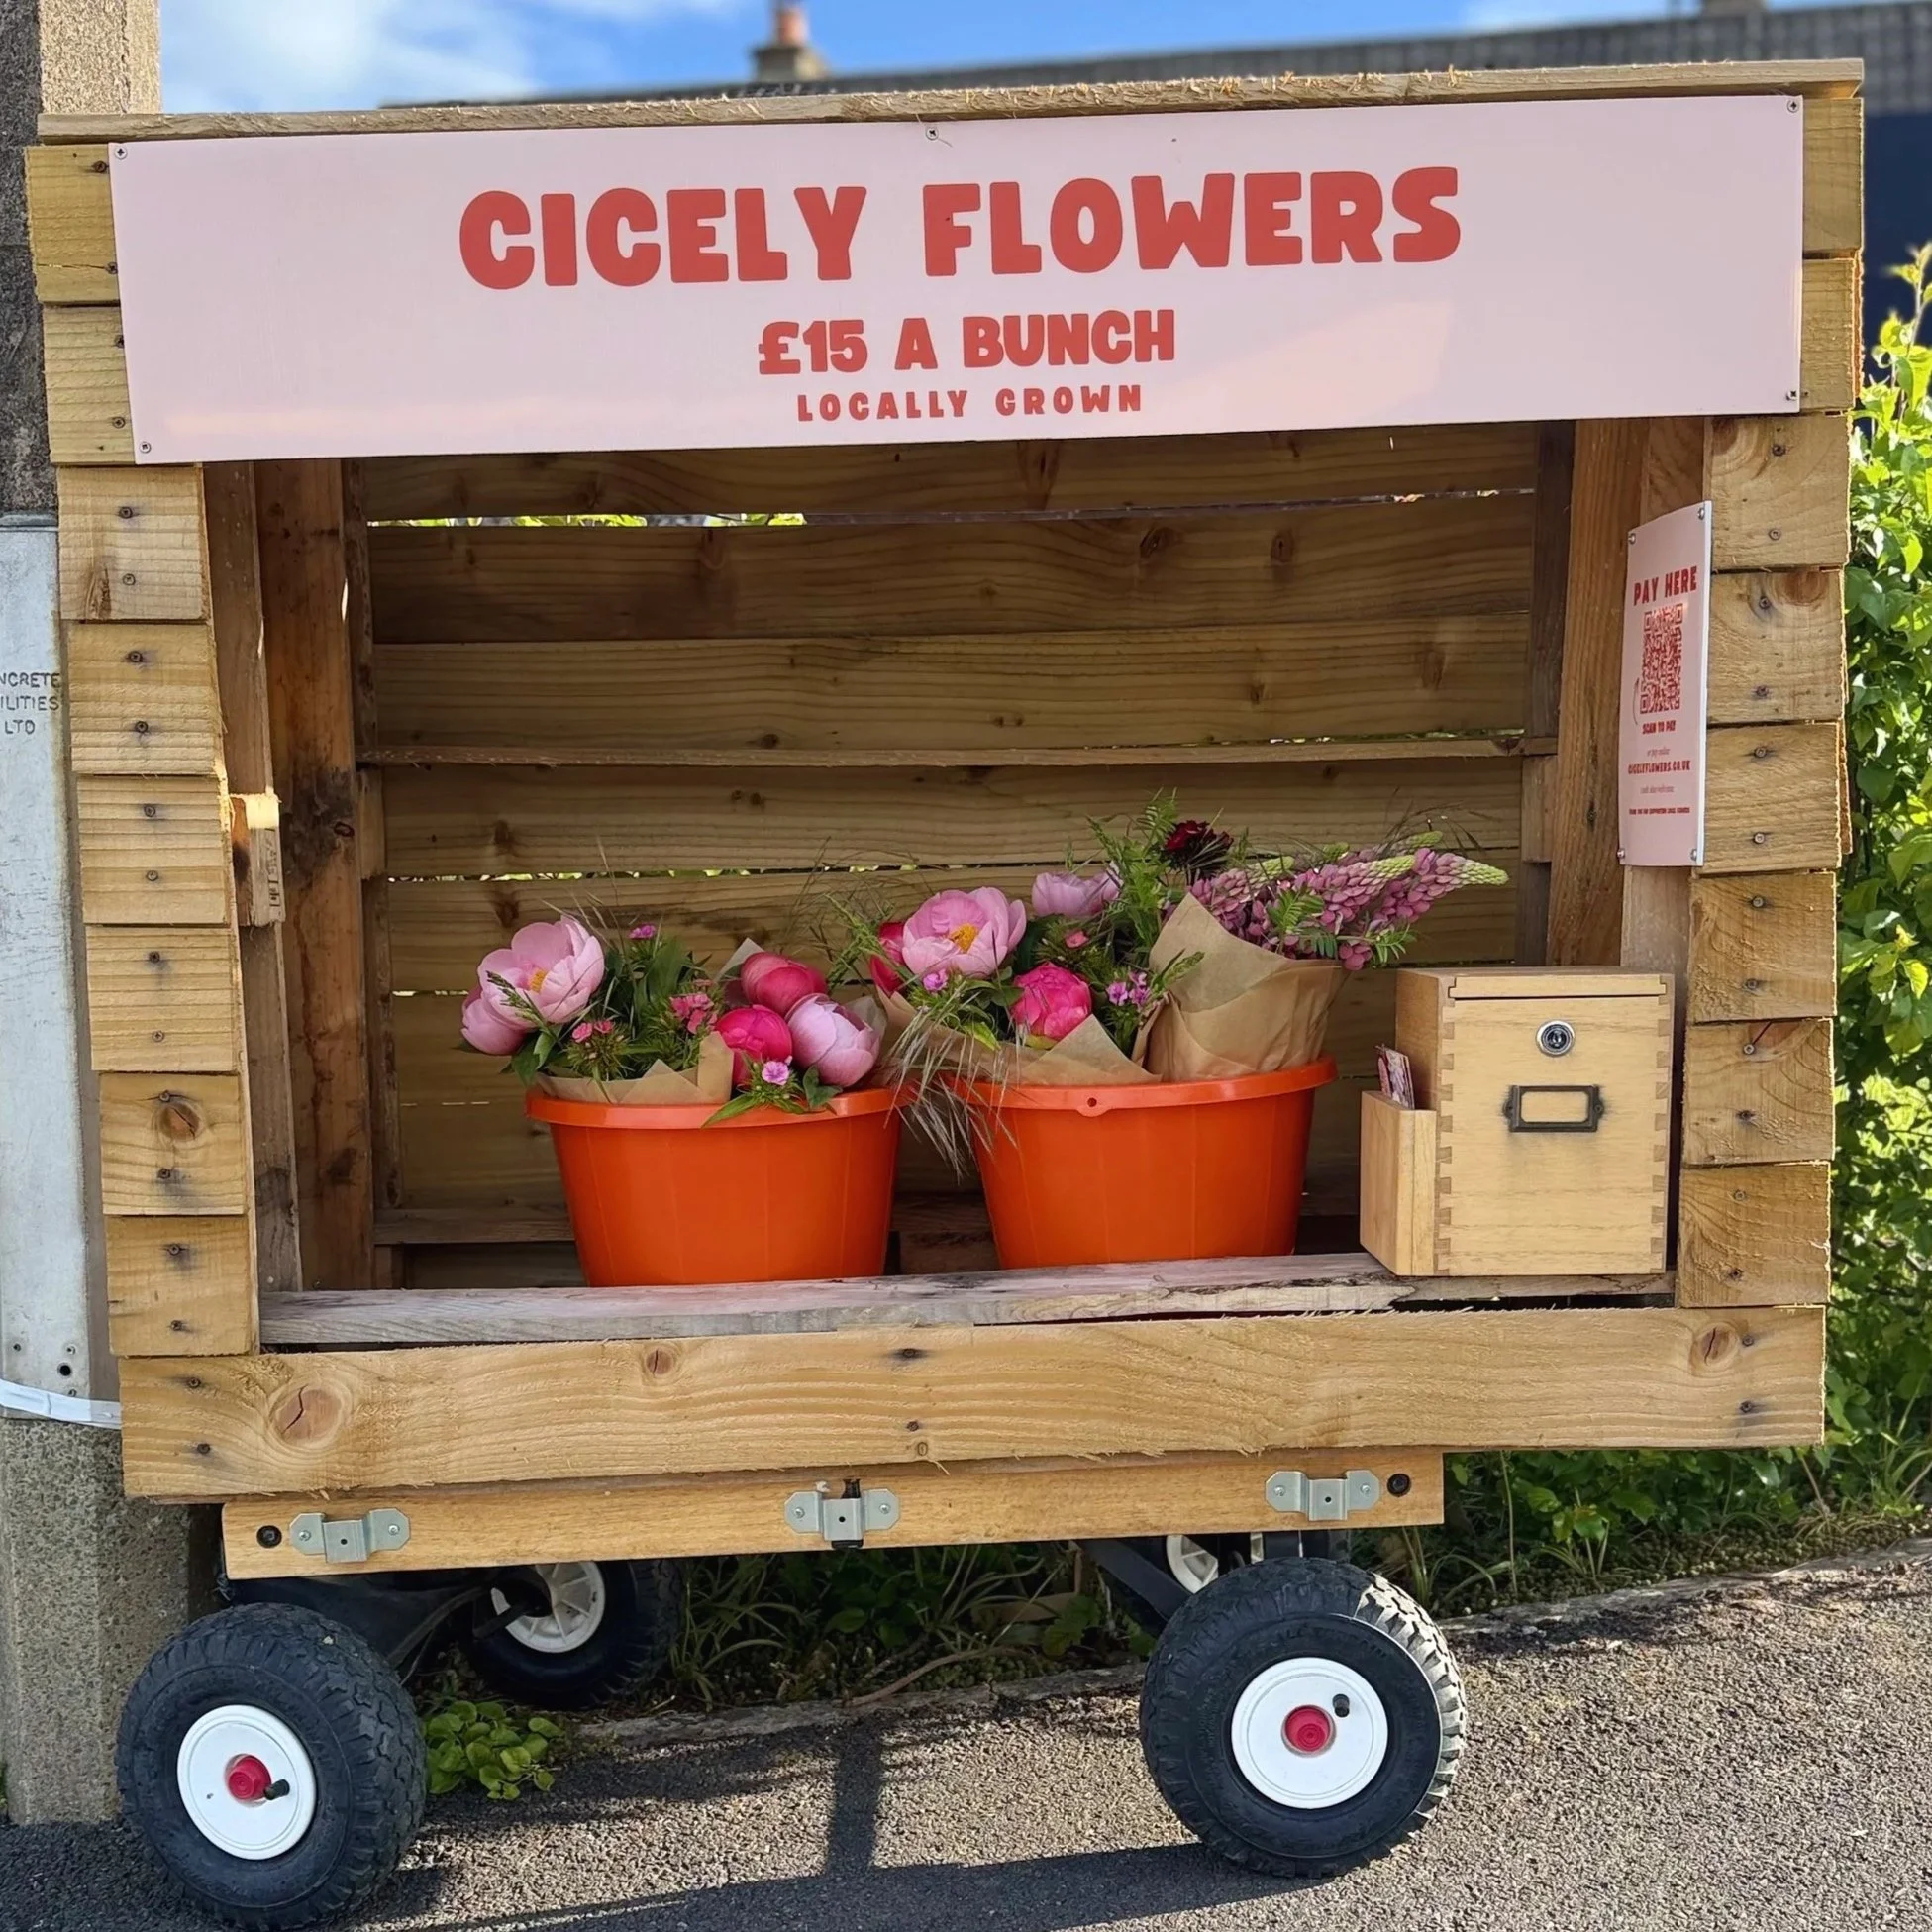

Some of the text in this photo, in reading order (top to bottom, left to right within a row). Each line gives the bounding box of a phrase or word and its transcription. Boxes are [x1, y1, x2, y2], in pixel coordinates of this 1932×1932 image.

[460, 167, 1461, 290] CICELY FLOWERS
[760, 308, 1175, 375] £15 A BUNCH
[797, 384, 1141, 421] LOCALLY GROWN
[1633, 565, 1697, 606] PAY HERE
